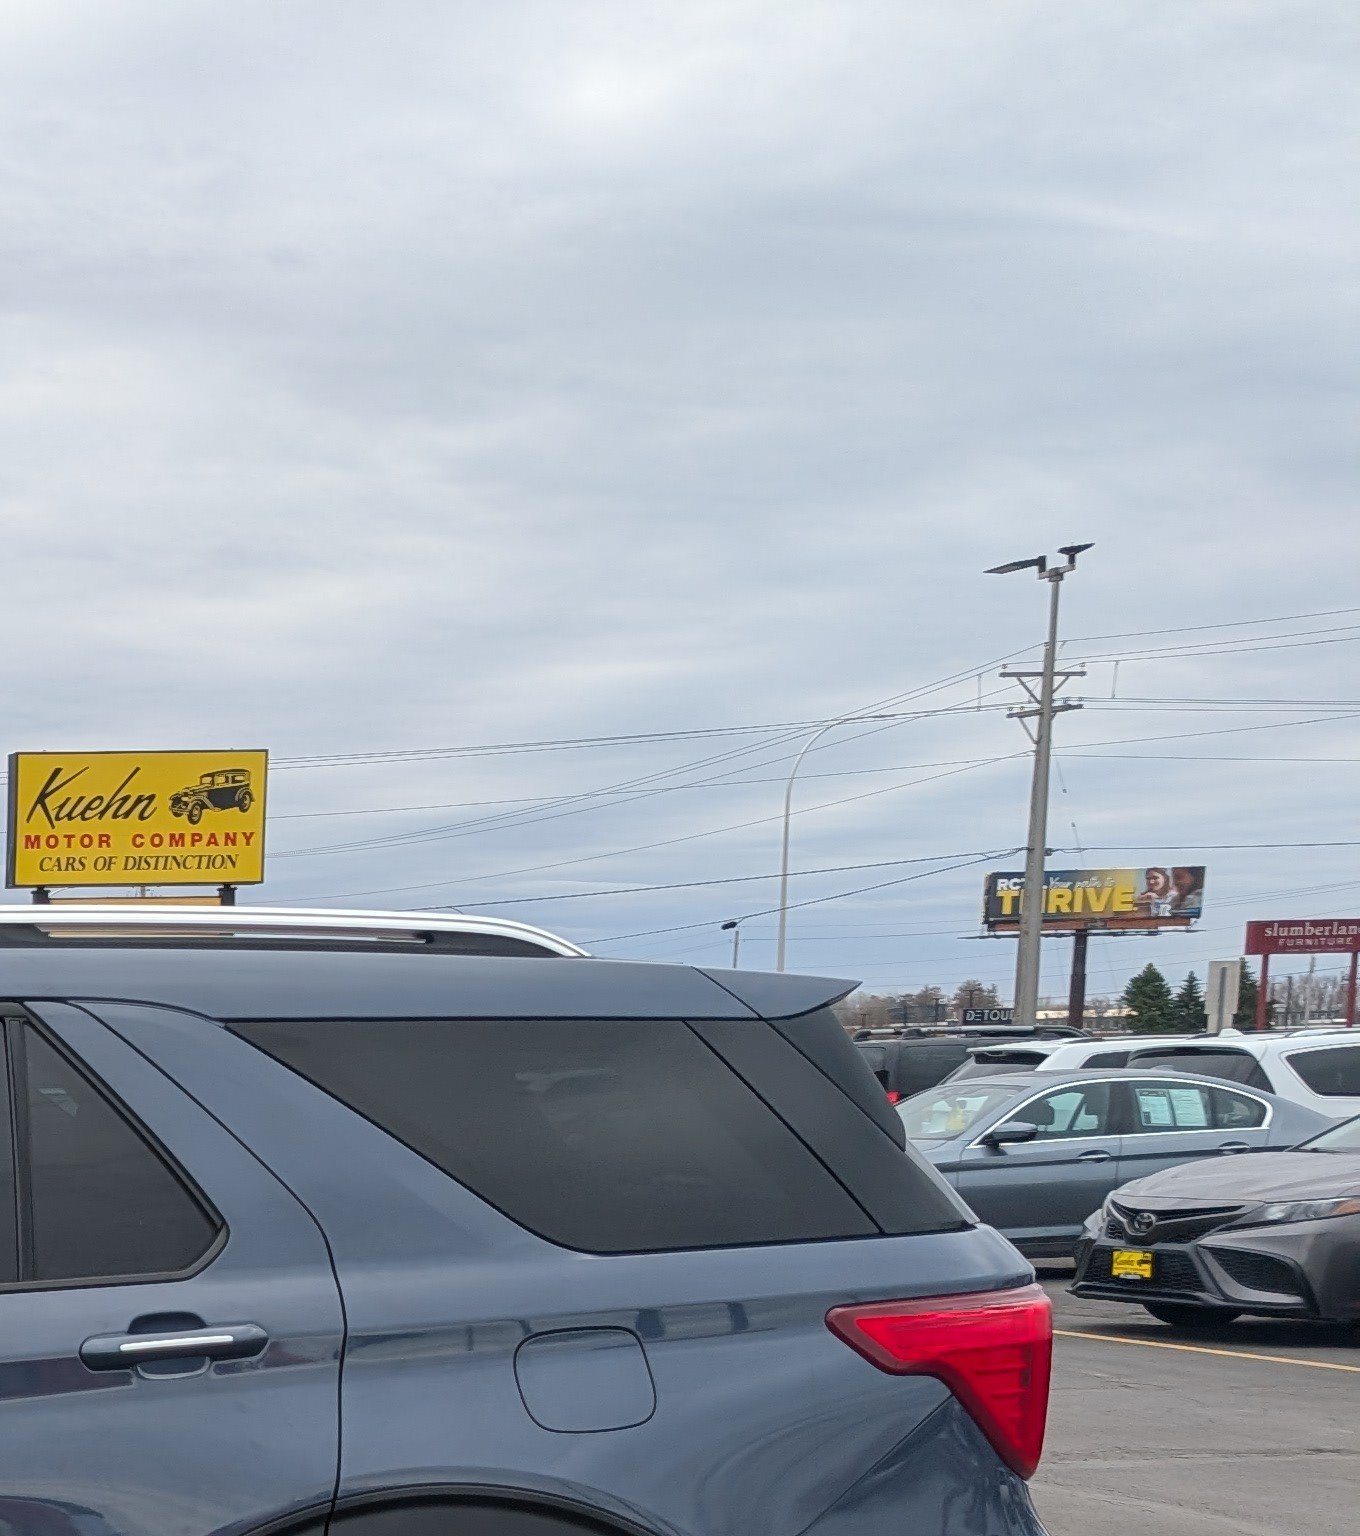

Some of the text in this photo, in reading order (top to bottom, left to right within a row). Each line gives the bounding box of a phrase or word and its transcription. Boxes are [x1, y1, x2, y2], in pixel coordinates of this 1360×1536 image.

[26, 766, 158, 829] Kuehn
[24, 831, 256, 850] MOTOR COMPANY
[38, 853, 240, 872] CARS OF DISTINCTION
[1264, 921, 1360, 937] slumberlan
